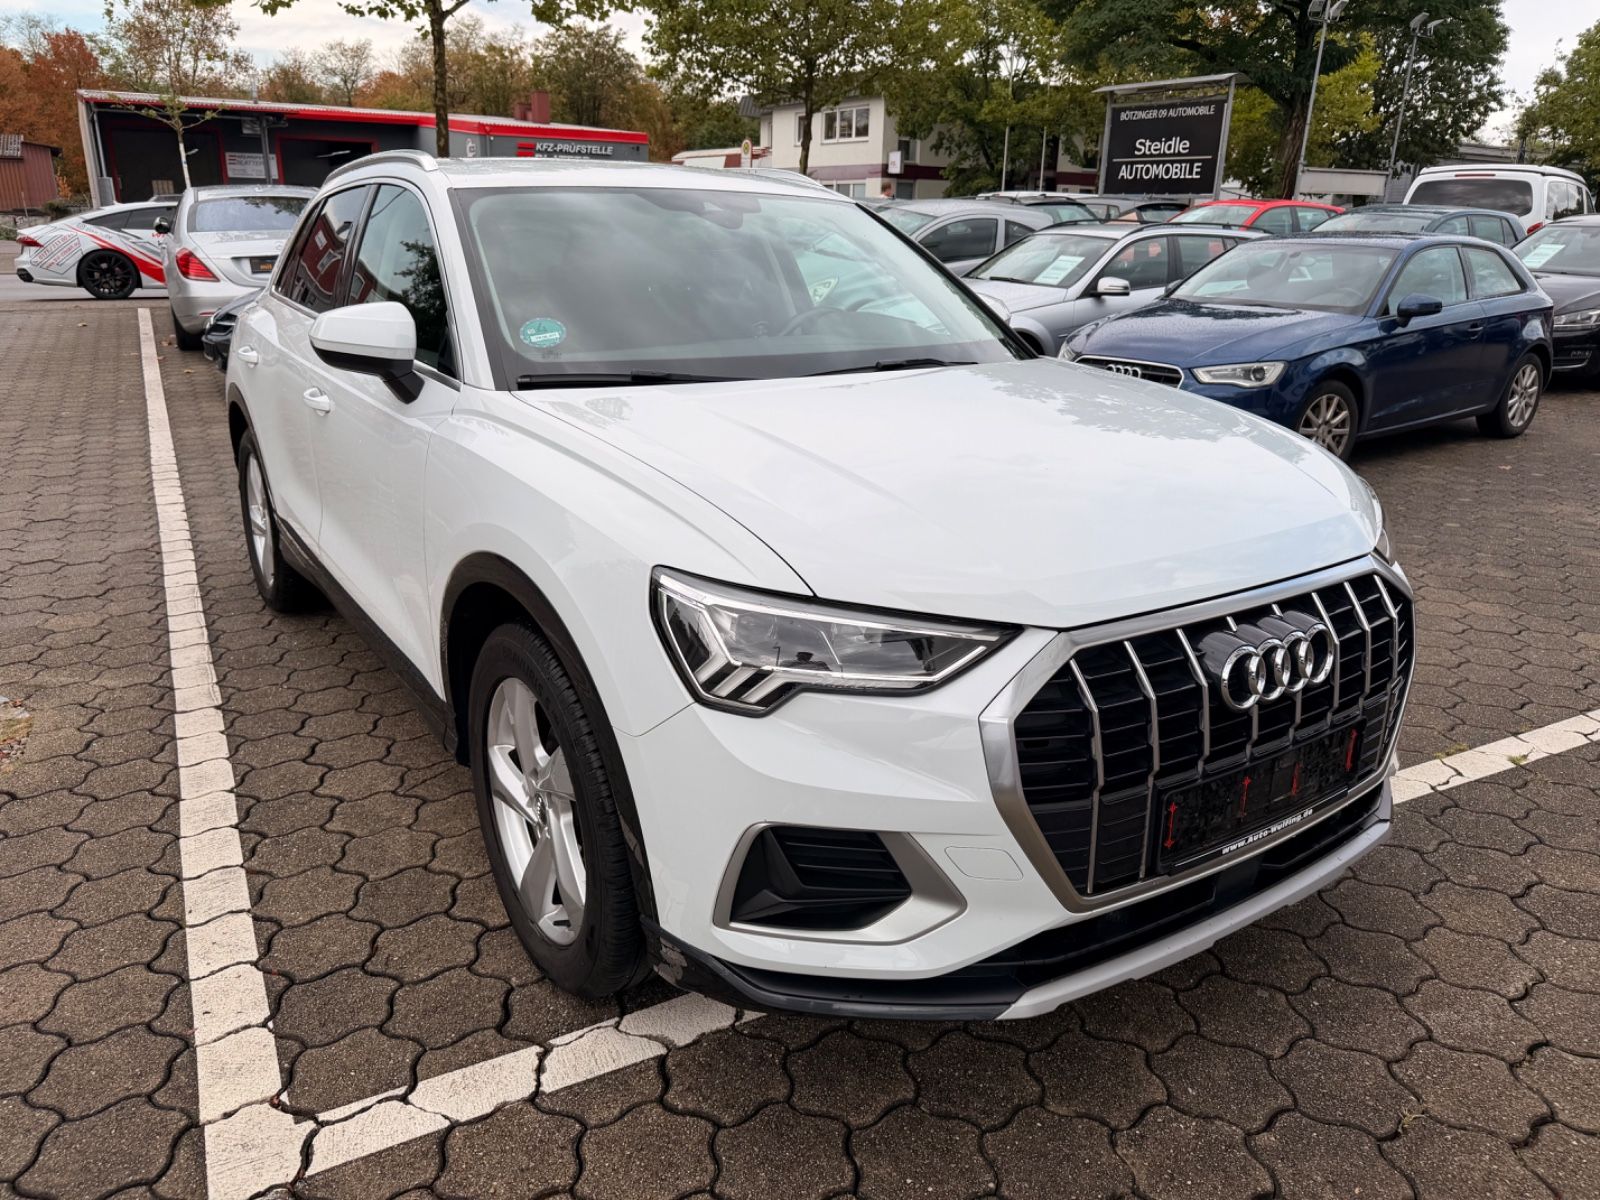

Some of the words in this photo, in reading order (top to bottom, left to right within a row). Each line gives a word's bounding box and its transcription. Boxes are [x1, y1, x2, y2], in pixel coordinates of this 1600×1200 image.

[1120, 109, 1158, 121] BÖTZINGER
[1158, 109, 1167, 119] 09
[1168, 105, 1216, 118] AUTOMOBILE
[535, 141, 614, 156] KFZ-PRÜFSTELLE
[1134, 136, 1190, 155] Steidle
[1118, 162, 1202, 180] AUTOMOBILE
